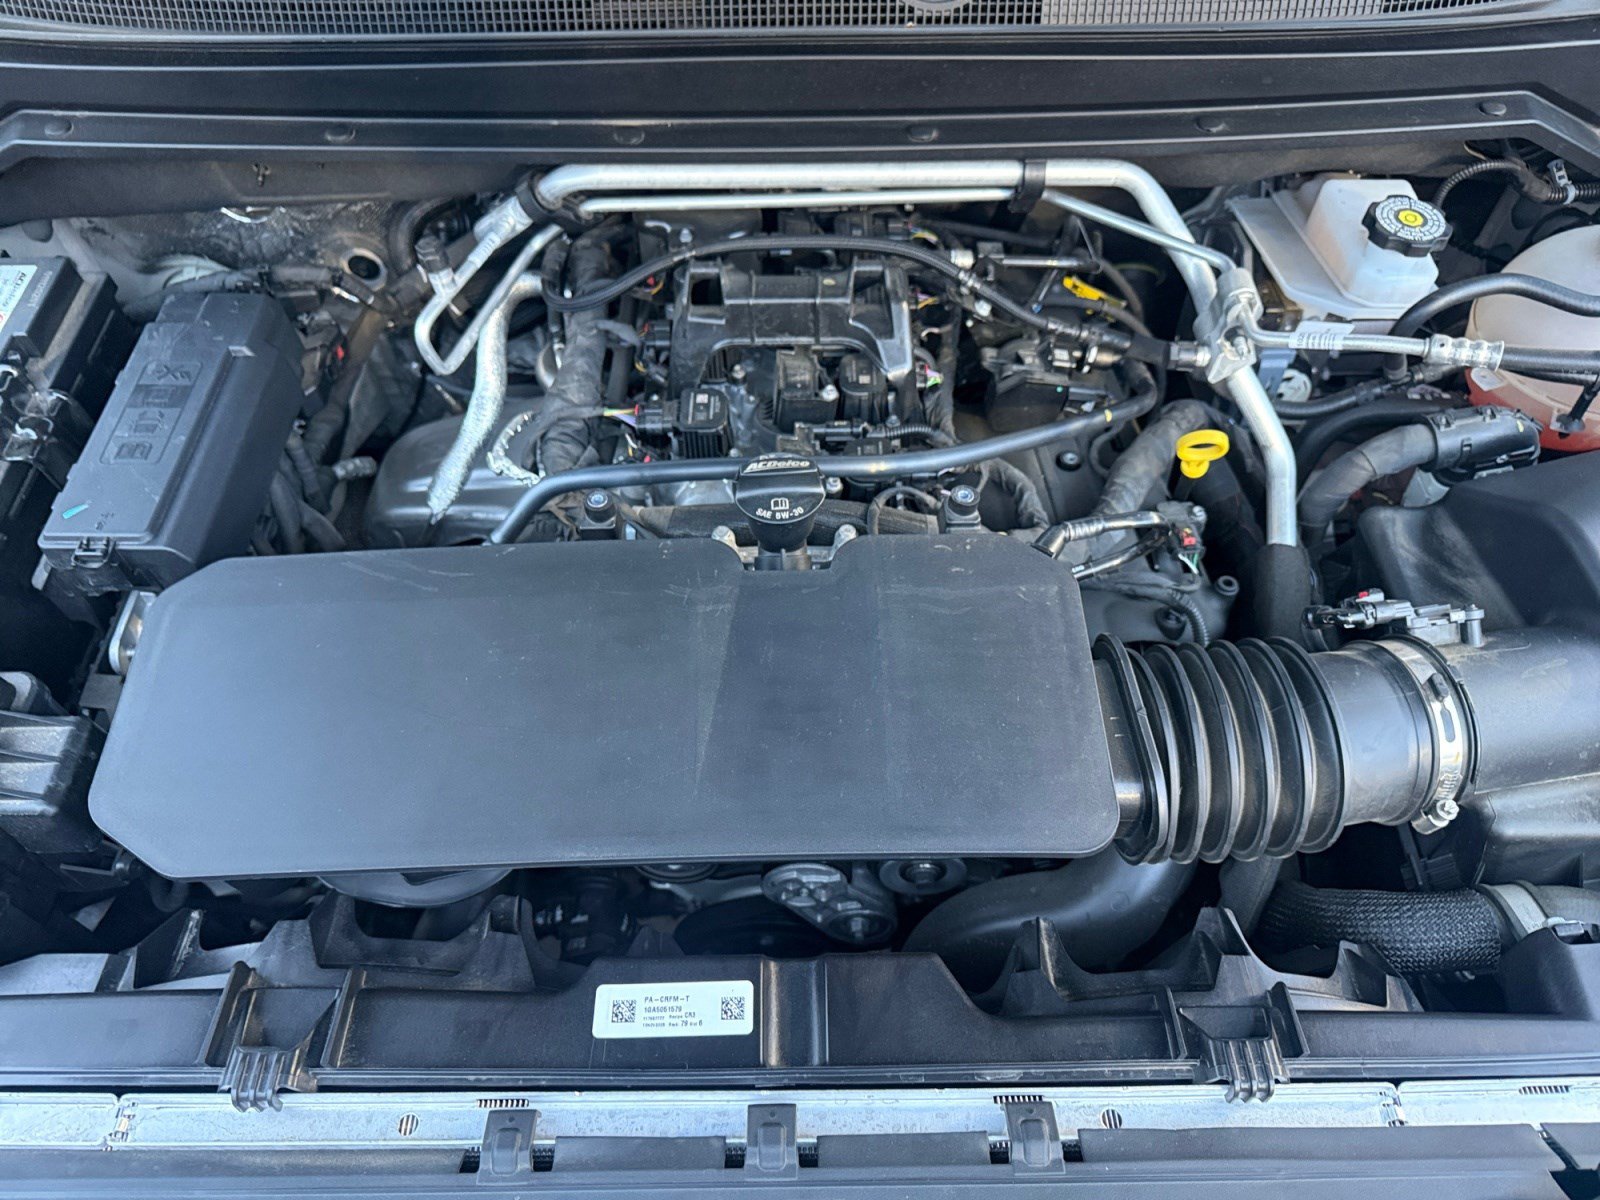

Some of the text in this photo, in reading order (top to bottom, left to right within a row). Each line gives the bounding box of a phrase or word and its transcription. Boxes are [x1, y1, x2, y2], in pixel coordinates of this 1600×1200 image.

[743, 459, 811, 473] ACDelco
[755, 506, 804, 520] SAE 5W-30
